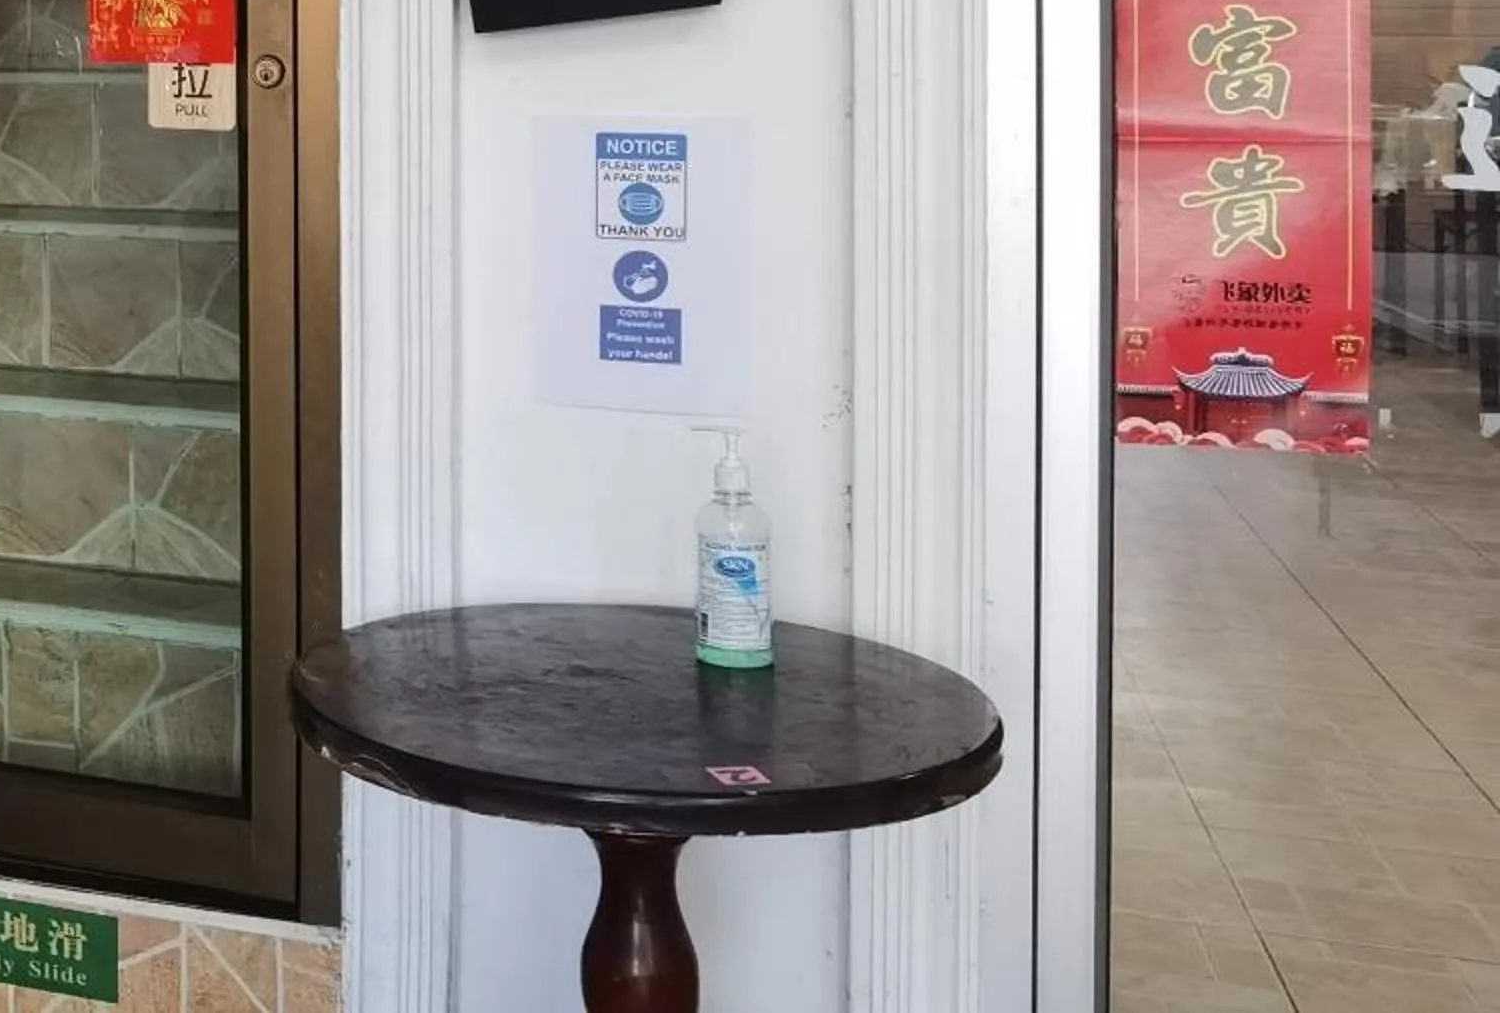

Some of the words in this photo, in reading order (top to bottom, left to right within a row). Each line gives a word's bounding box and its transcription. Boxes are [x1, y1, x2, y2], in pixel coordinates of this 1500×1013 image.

[172, 63, 213, 99] 拉
[606, 138, 678, 156] NOTICE
[599, 160, 646, 172] PLEASE
[648, 162, 683, 172] WEAR
[613, 173, 643, 183] FACE
[646, 174, 680, 185] MASK
[599, 224, 649, 236] THANK
[653, 226, 685, 238] YOU
[29, 961, 89, 987] Slide
